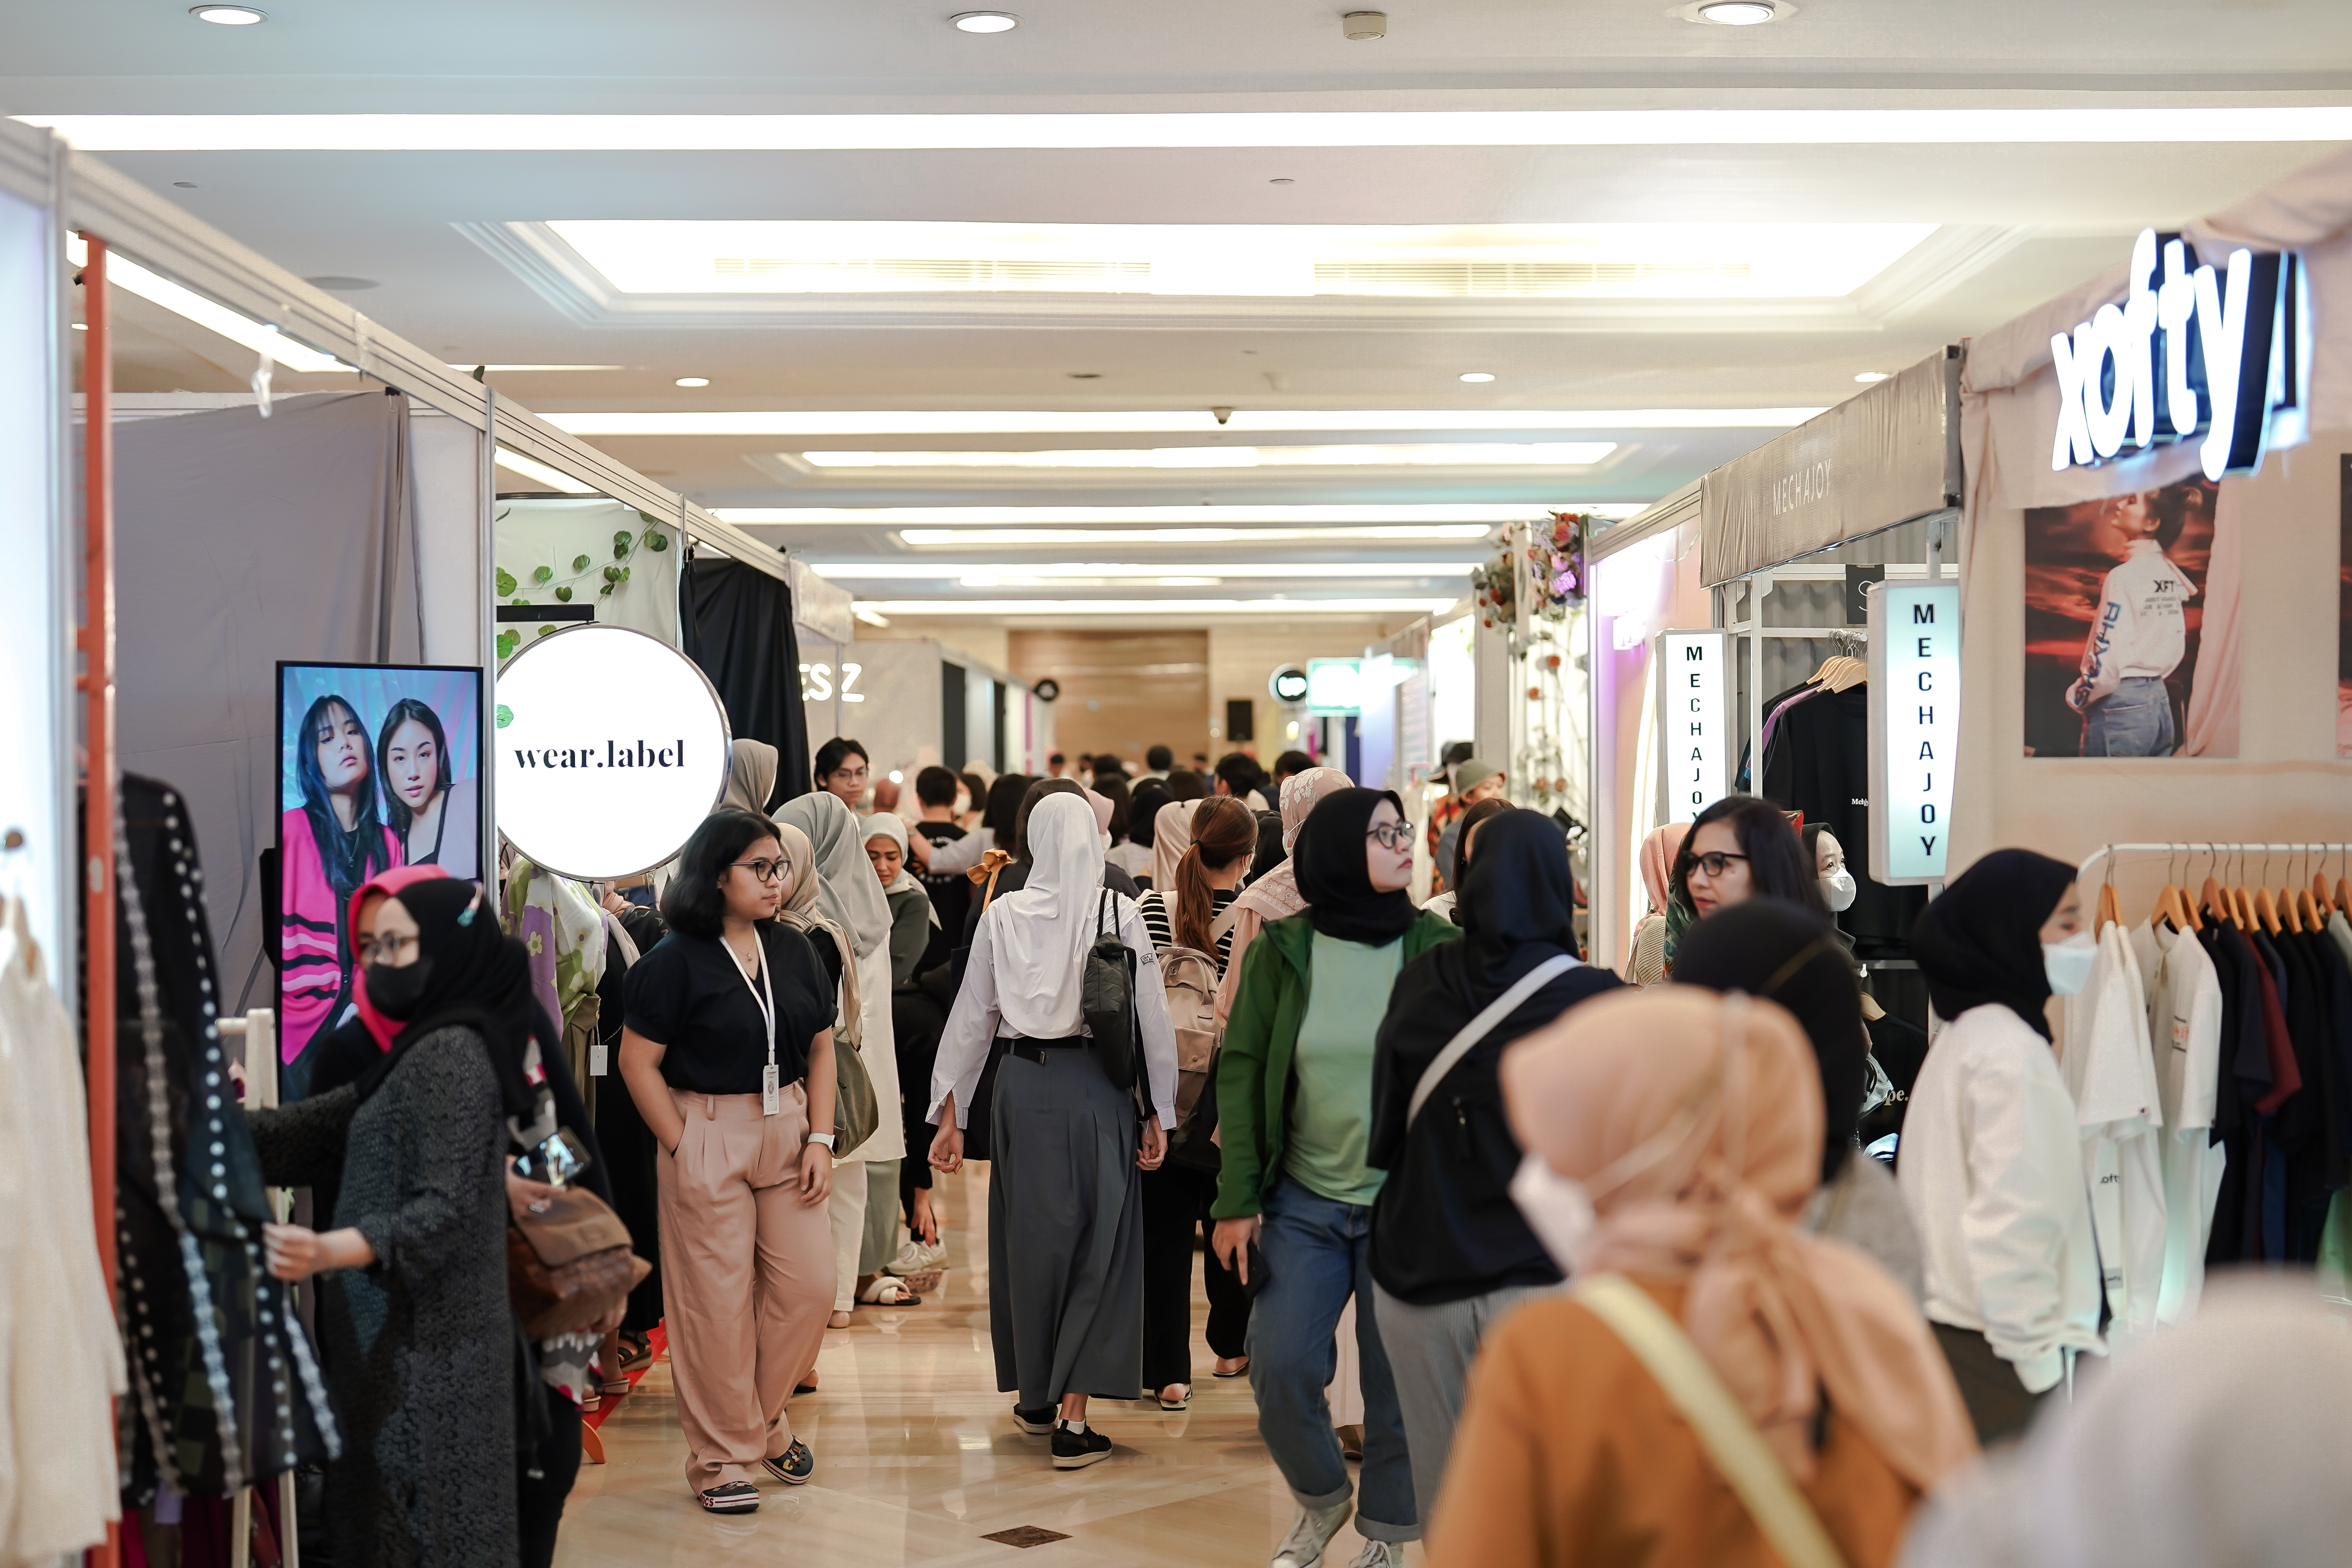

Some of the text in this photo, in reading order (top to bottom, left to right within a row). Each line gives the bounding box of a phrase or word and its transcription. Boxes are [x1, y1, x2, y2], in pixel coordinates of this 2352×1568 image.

[2051, 227, 2252, 481] xofty
[1773, 458, 1831, 517] MECHAJOY
[514, 740, 684, 768] wear.label
[1913, 604, 1936, 856] MECHAJOY
